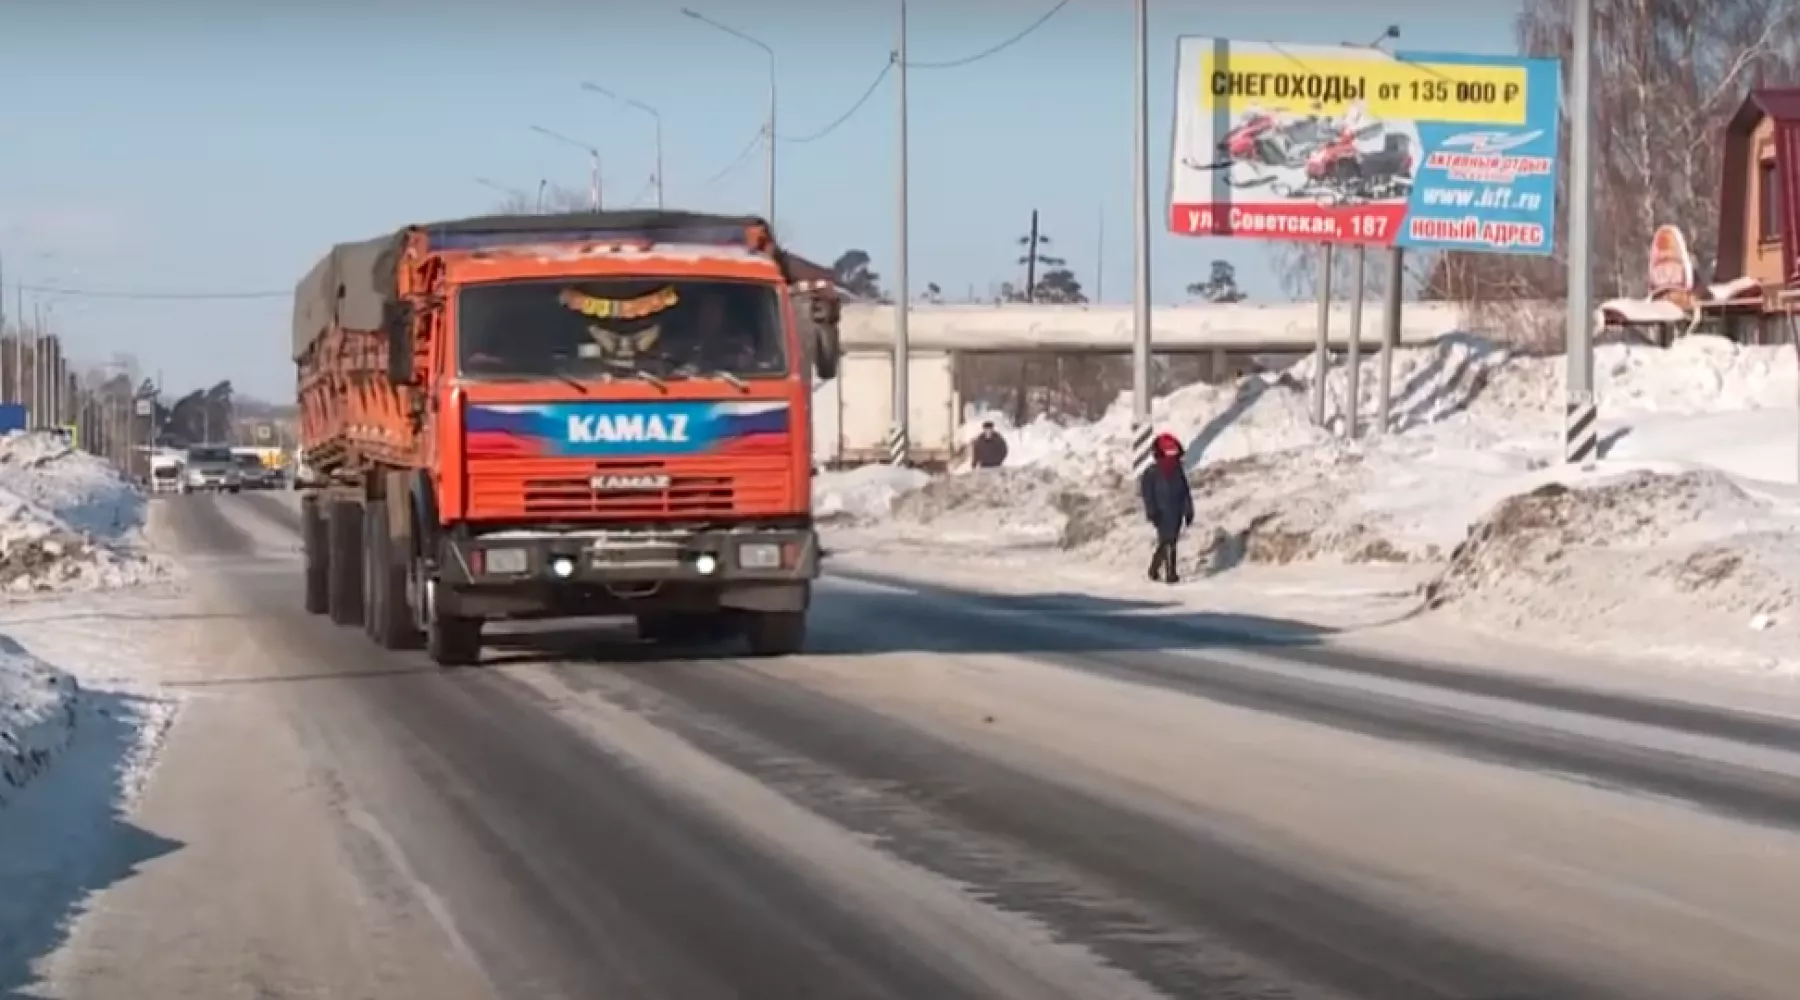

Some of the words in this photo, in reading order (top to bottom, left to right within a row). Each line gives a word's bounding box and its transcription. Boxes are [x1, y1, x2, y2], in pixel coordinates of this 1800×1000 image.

[1211, 70, 1365, 103] СНЕГОХОДЫ
[1379, 83, 1401, 99] от
[1410, 81, 1448, 101] 135
[1457, 82, 1496, 103] 000
[1229, 207, 1342, 237] Советская,
[1351, 215, 1388, 237] 187
[1411, 216, 1478, 240] НОВЫЙ
[1482, 221, 1543, 245] АДРЕС
[568, 414, 689, 442] KAMAZ
[590, 474, 670, 489] KAMAZ
